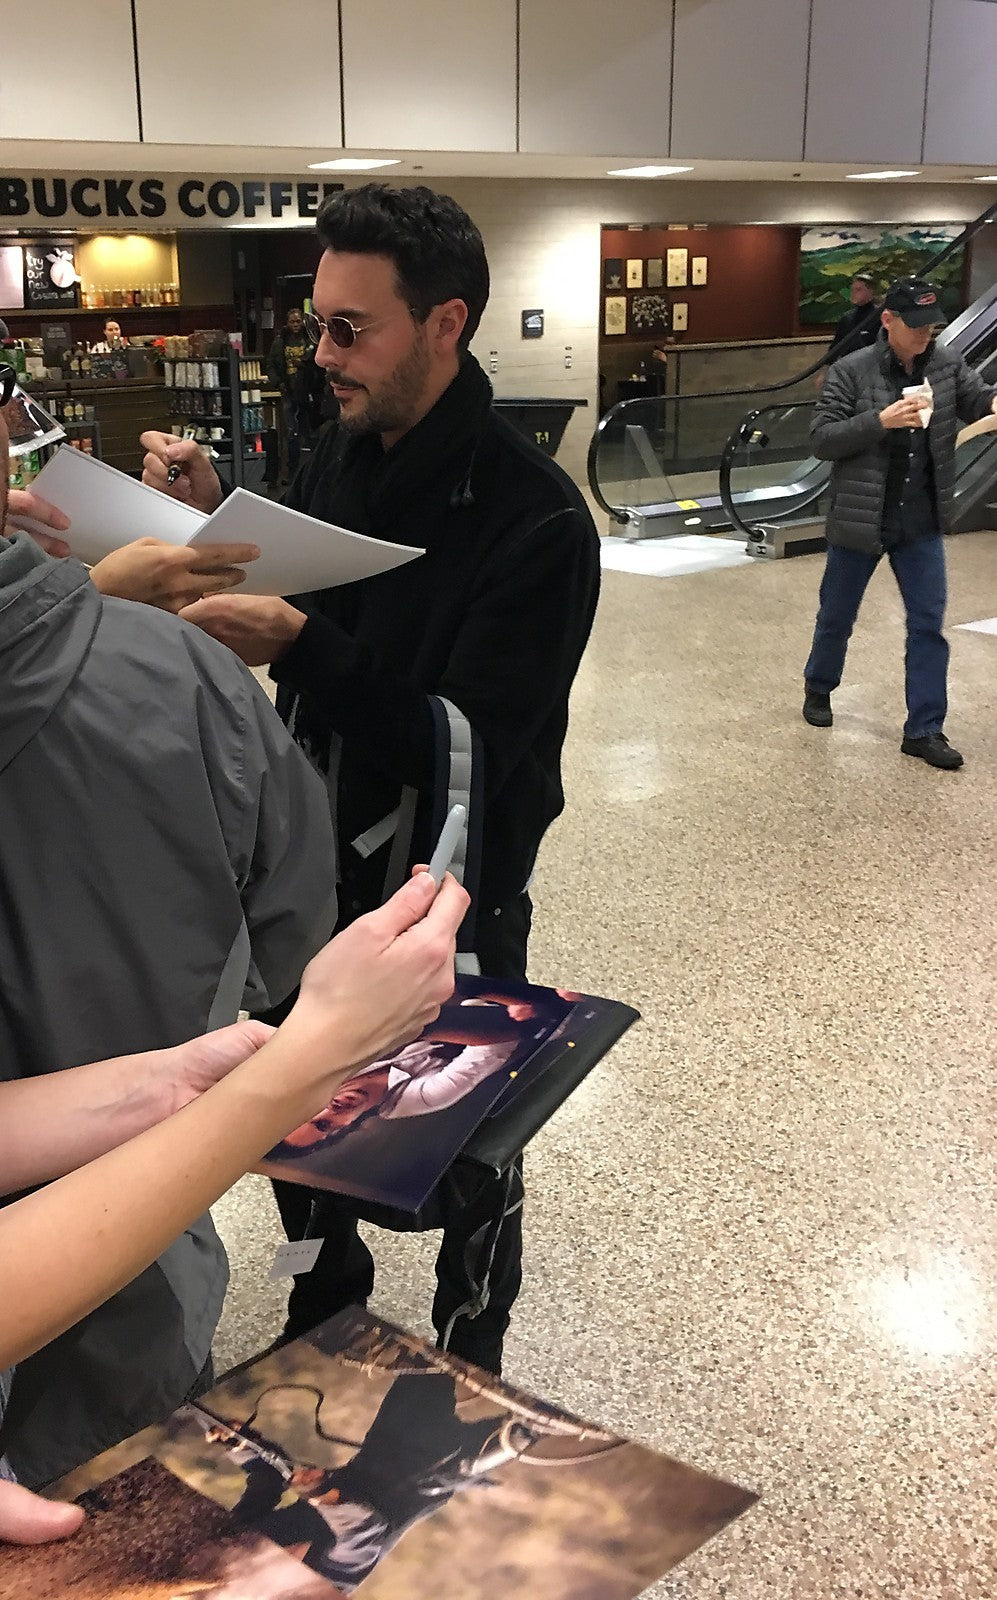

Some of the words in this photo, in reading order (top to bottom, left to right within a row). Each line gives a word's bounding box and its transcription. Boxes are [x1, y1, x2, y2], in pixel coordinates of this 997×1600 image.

[0, 178, 166, 217] BUCKS
[26, 251, 44, 270] try
[27, 270, 44, 279] our
